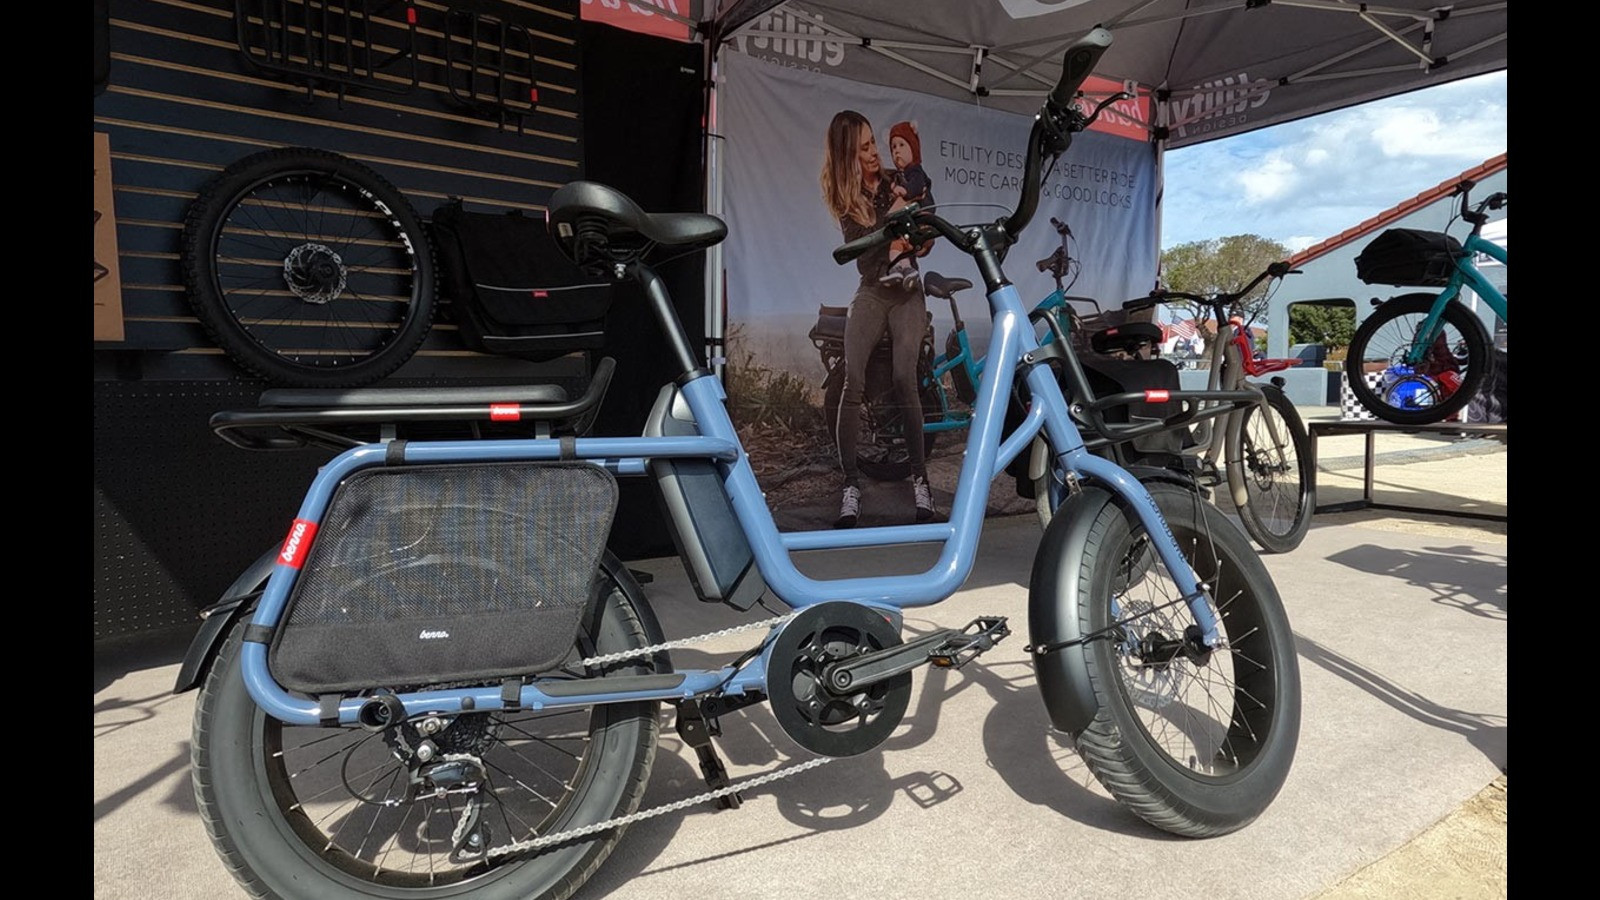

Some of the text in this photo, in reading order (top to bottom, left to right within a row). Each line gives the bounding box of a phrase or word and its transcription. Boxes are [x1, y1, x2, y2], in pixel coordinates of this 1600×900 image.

[940, 140, 992, 164] ETILITY
[1054, 162, 1061, 175] A
[1064, 162, 1109, 183] BETTER
[945, 167, 985, 188] MORE
[1055, 184, 1092, 202] GOOD
